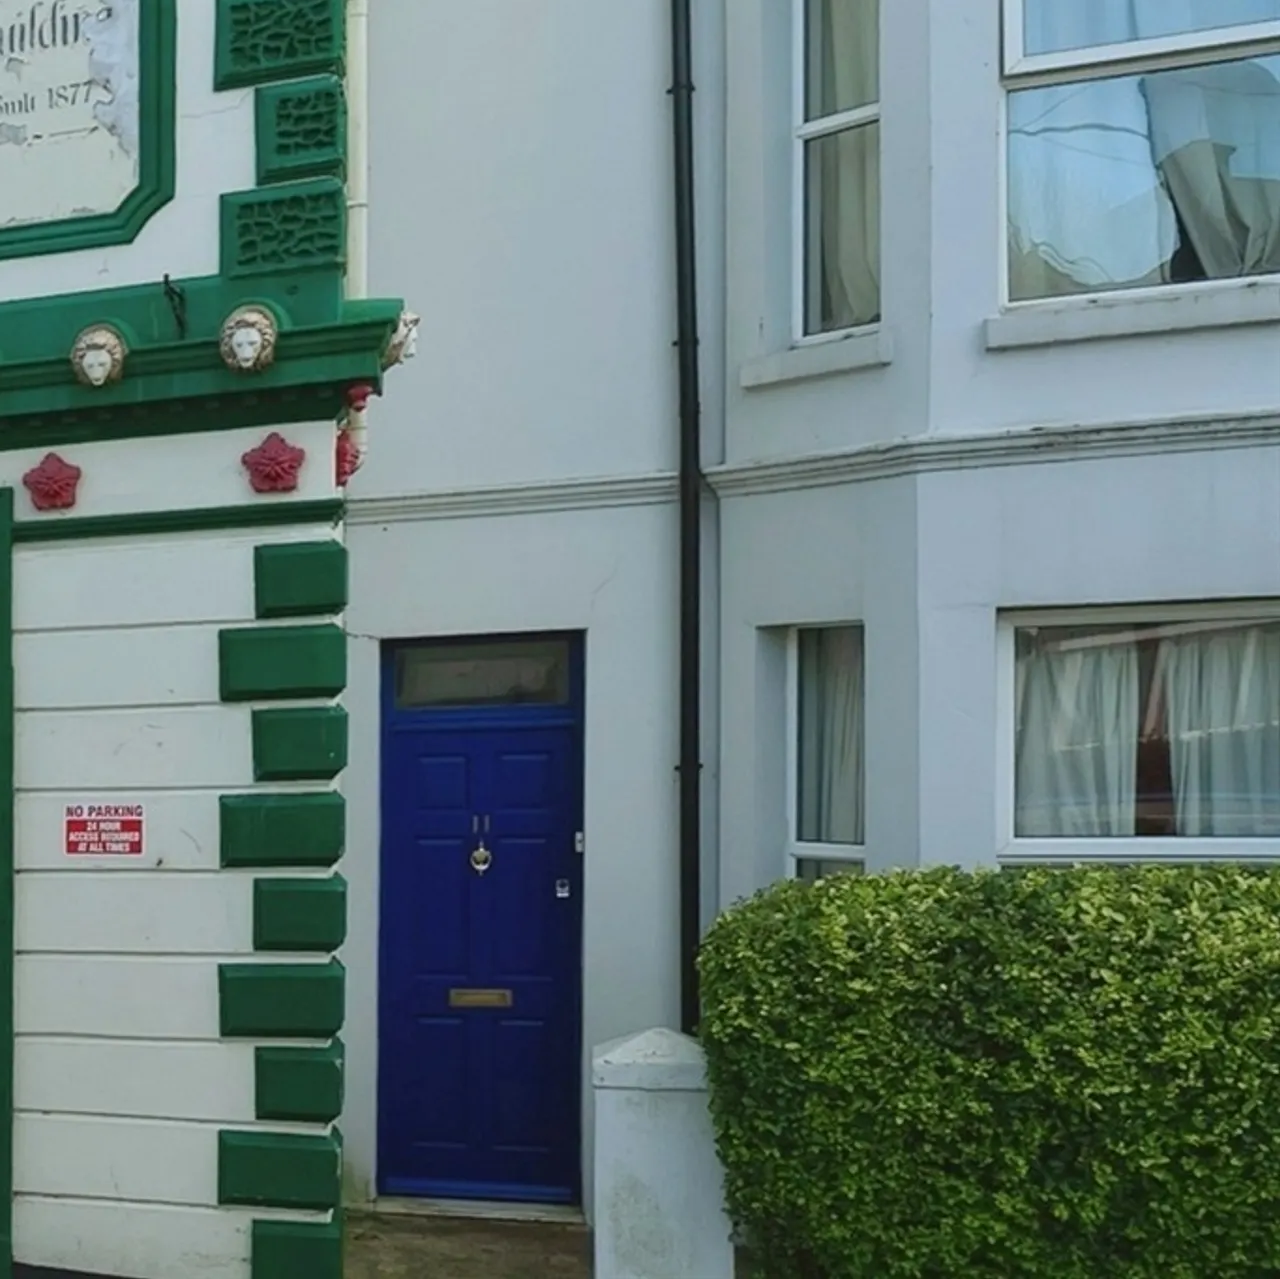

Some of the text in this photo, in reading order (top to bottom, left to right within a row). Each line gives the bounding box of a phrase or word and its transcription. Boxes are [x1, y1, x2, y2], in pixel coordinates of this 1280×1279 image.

[48, 79, 96, 108] 1877
[66, 805, 143, 817] NO PARKING
